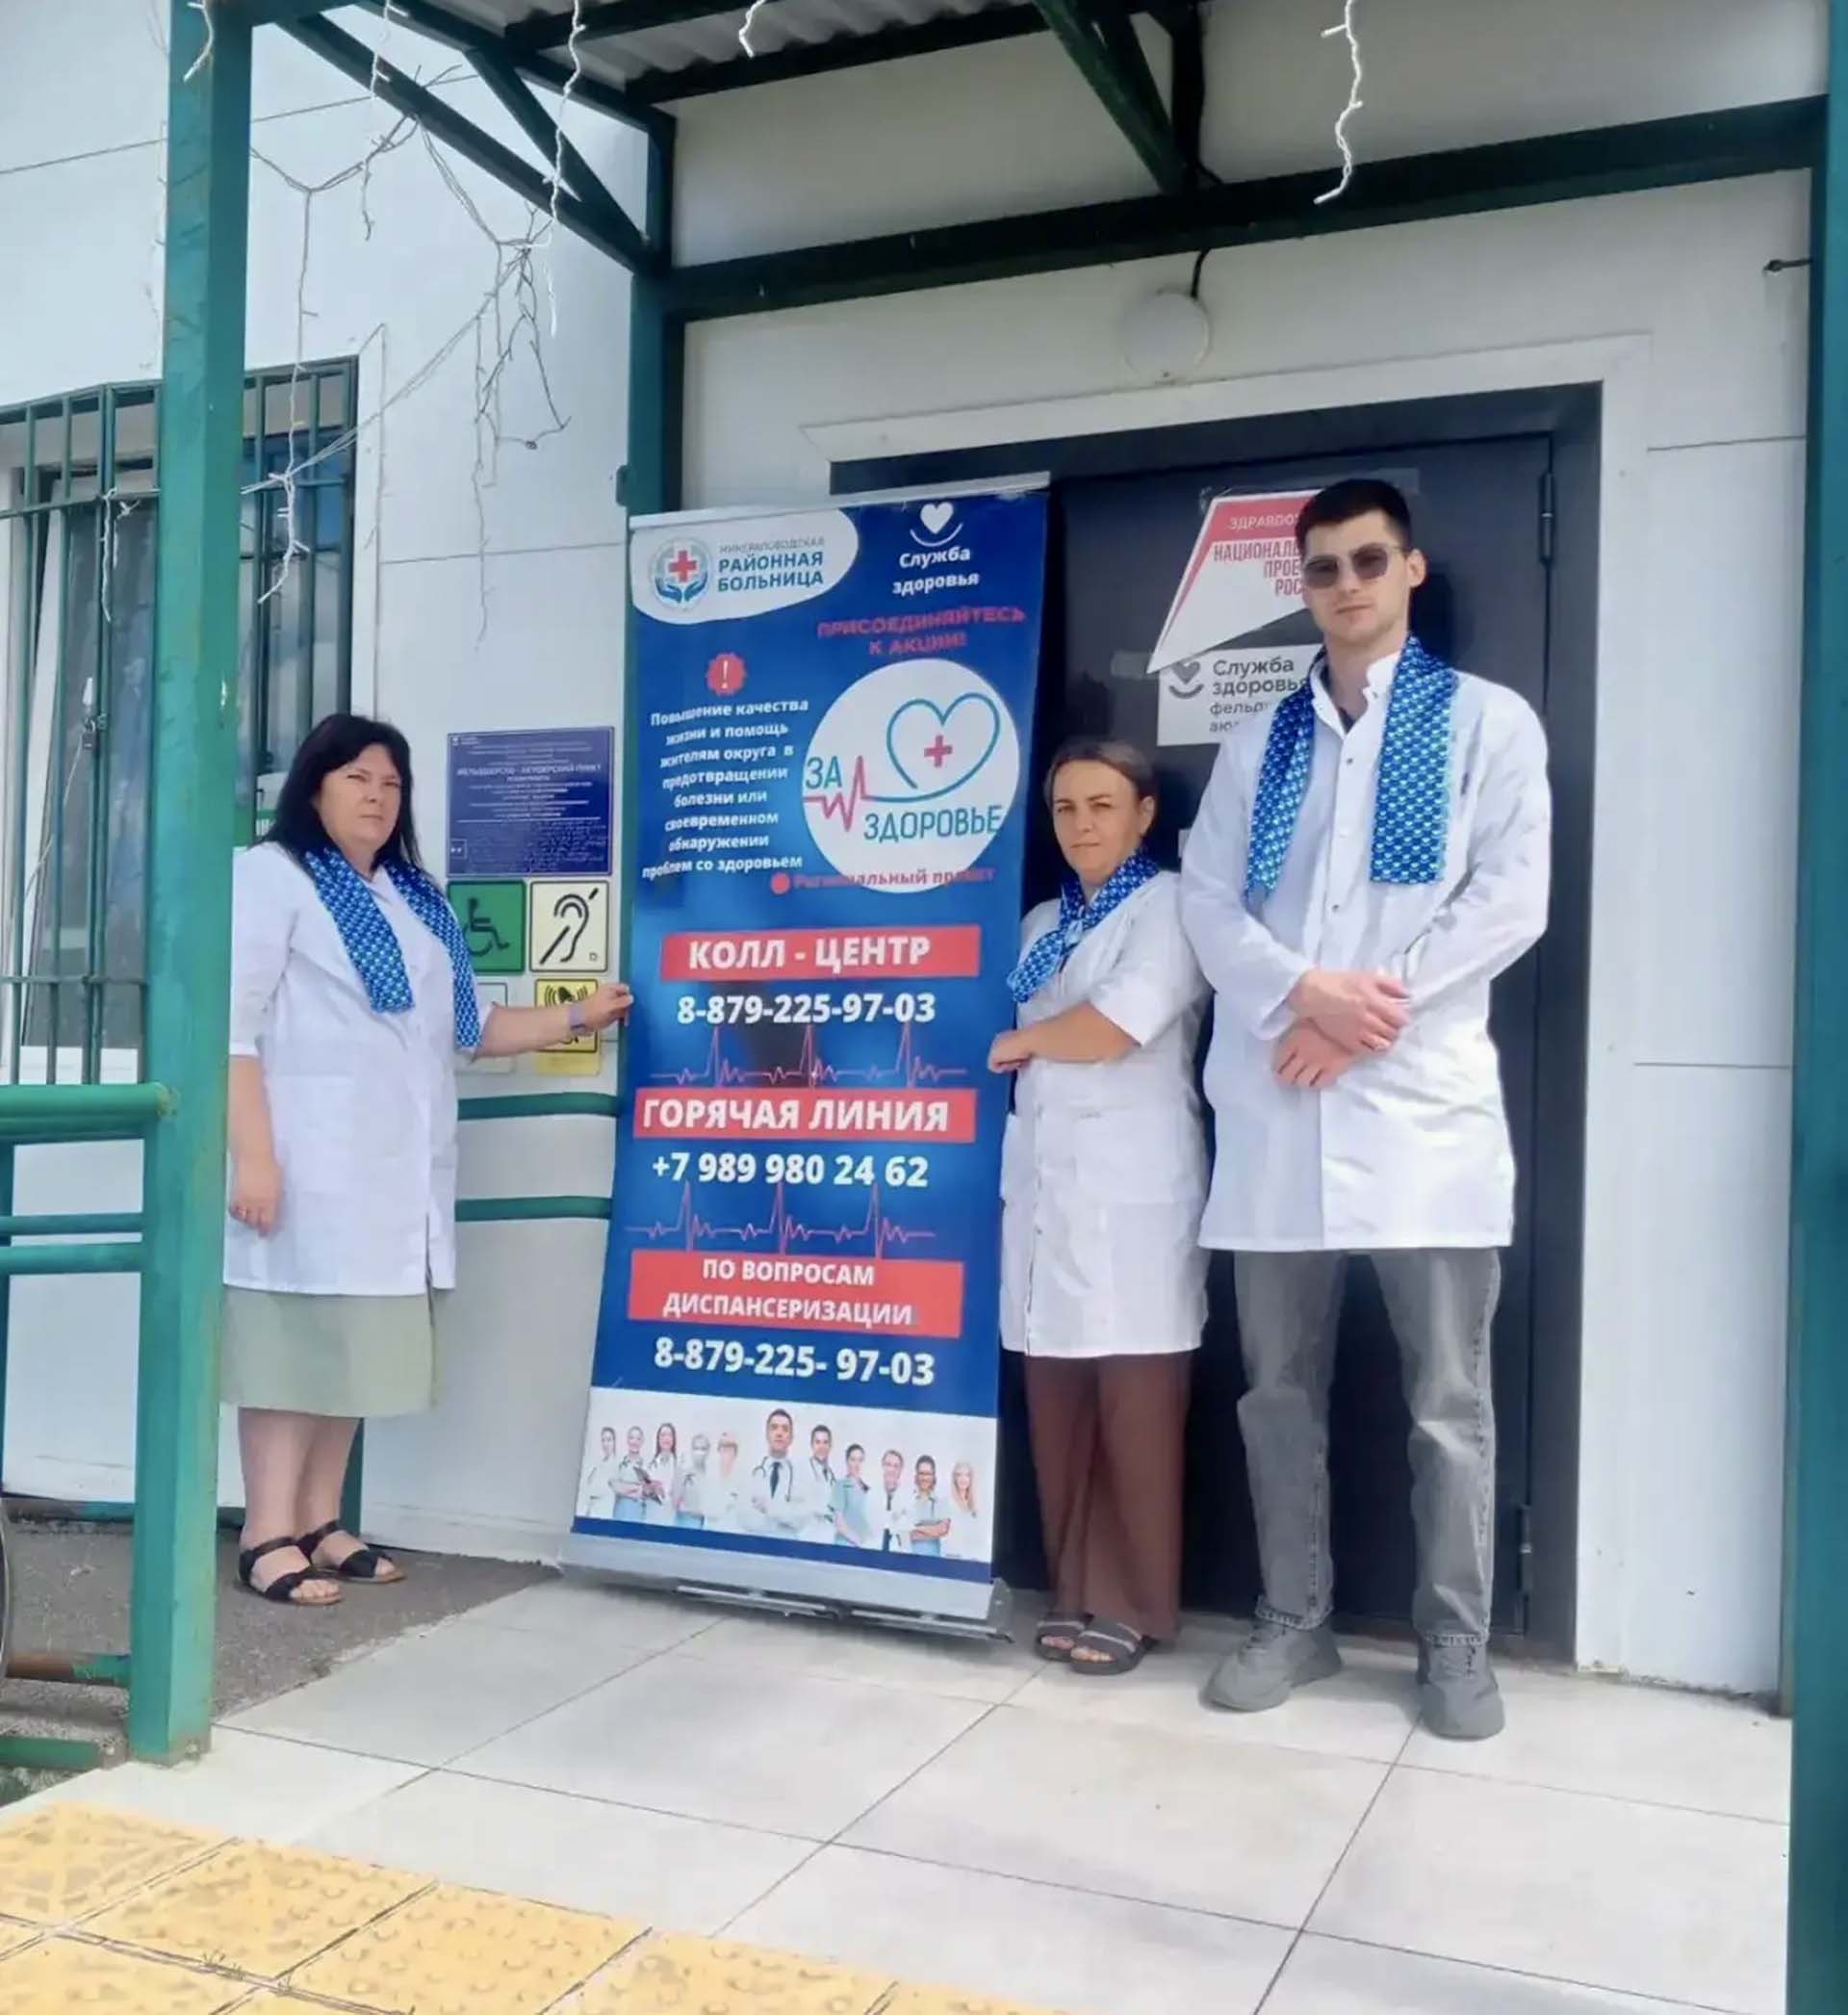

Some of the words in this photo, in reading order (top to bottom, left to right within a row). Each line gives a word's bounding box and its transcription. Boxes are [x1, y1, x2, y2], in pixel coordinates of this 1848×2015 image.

[718, 552, 823, 573] РАЙОННАЯ
[899, 546, 970, 569] Служба
[718, 572, 823, 592] БОЛЬНИЦА
[892, 573, 980, 596] здоровья
[817, 606, 1026, 635] ПРИСОЕДИНЯЙТЕСЬ
[869, 640, 883, 655] К
[1213, 656, 1294, 679] Служба
[651, 704, 732, 727] Повышение
[736, 700, 808, 716] качества
[665, 727, 706, 746] жизни
[710, 727, 721, 738] и
[725, 723, 788, 738] помощь
[659, 749, 719, 768] жителям
[724, 745, 776, 762] округа
[783, 745, 794, 756] в
[662, 767, 787, 791] предотвращении
[806, 755, 843, 789] ЗА
[674, 791, 733, 808] болезни
[737, 790, 767, 804] или
[664, 813, 779, 832] своевременном
[863, 805, 1002, 843] ЗДОРОВЬЕ
[668, 835, 769, 852] обнаружении
[642, 860, 692, 880] проблем
[696, 860, 713, 871] со
[717, 857, 803, 873] здоровьем
[689, 939, 785, 970] КОЛЛ
[795, 951, 806, 961] -
[815, 936, 931, 973] ЦЕНТР
[678, 994, 936, 1024] 8-879-225-97-03
[643, 1098, 800, 1129] ГОРЯЧАЯ
[808, 1100, 949, 1132] ЛИНИЯ
[653, 1152, 690, 1181] +7
[698, 1153, 756, 1182] 989
[765, 1154, 825, 1184] 980
[834, 1156, 876, 1185] 24
[885, 1156, 929, 1187] 62
[703, 1257, 734, 1280] ПО
[742, 1260, 874, 1286] ВОПРОСАМ
[663, 1293, 913, 1329] ДИСПАНСЕРИЗАЦИИ
[654, 1337, 827, 1378] 8-879-225-
[836, 1349, 936, 1386] 97-03
